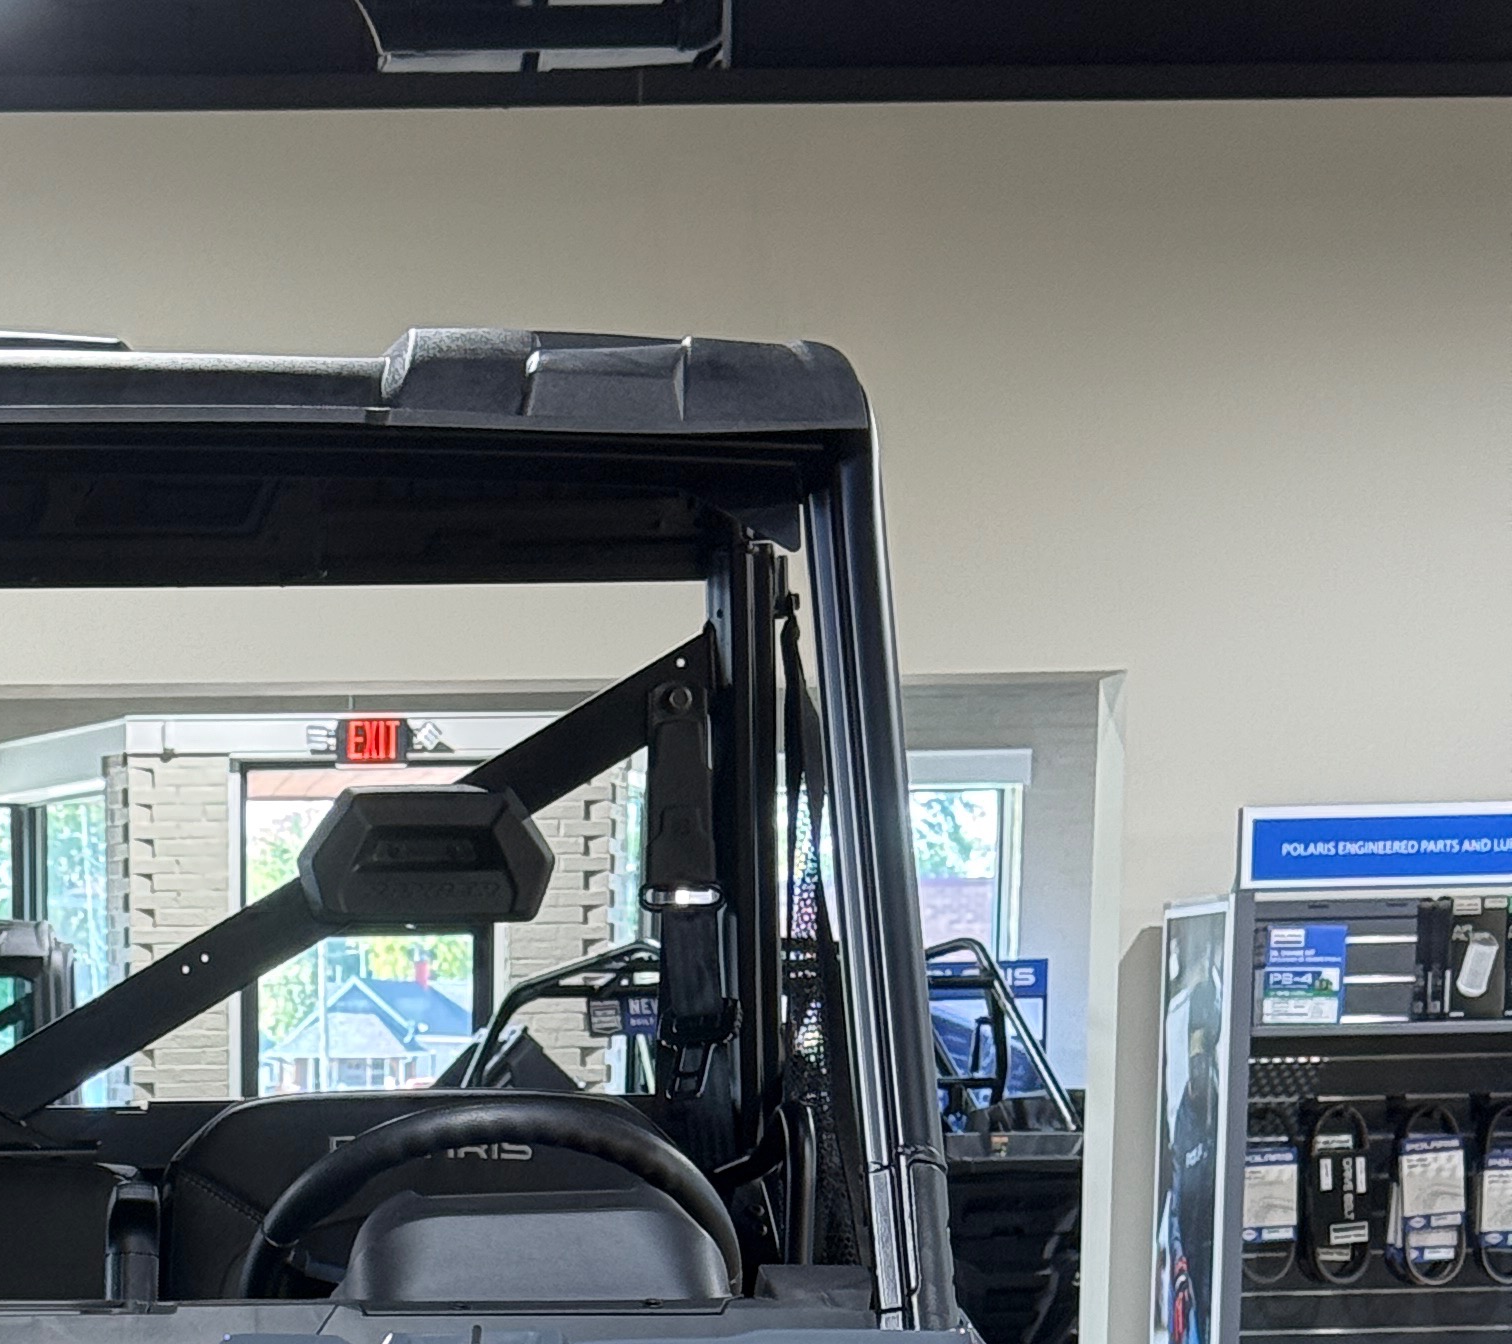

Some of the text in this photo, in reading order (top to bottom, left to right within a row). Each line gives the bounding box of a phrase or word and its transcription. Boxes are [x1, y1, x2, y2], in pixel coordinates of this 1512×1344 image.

[346, 720, 401, 760] EXIT
[1281, 841, 1336, 857] POLARIS
[1337, 838, 1419, 855] ENGINEERED
[1420, 838, 1460, 853] PARTS
[1461, 837, 1492, 853] AND
